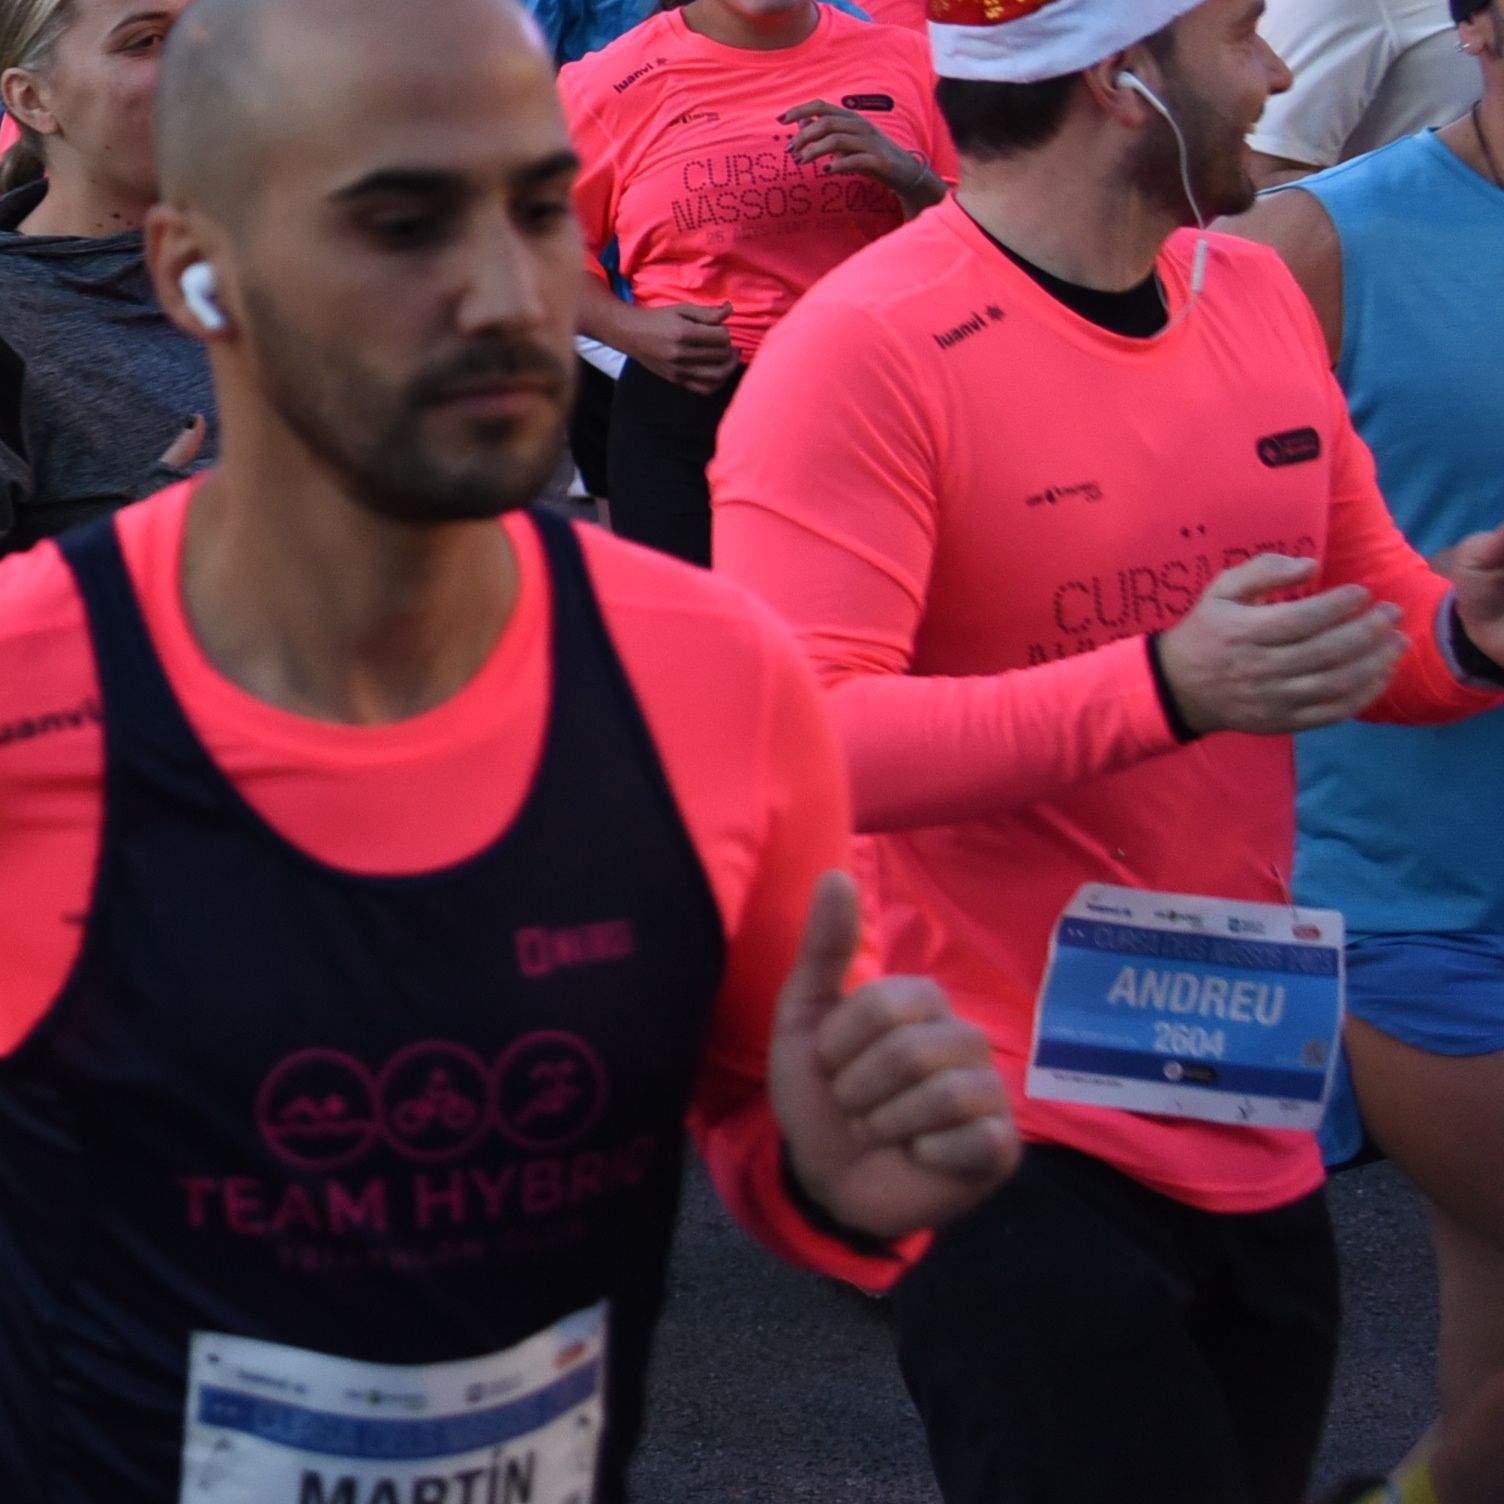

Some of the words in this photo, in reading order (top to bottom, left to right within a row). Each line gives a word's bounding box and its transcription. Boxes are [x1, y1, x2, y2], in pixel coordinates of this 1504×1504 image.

[670, 183, 812, 233] NASSOS
[1106, 965, 1286, 1028] ANDREU
[179, 1171, 387, 1238] TEAM
